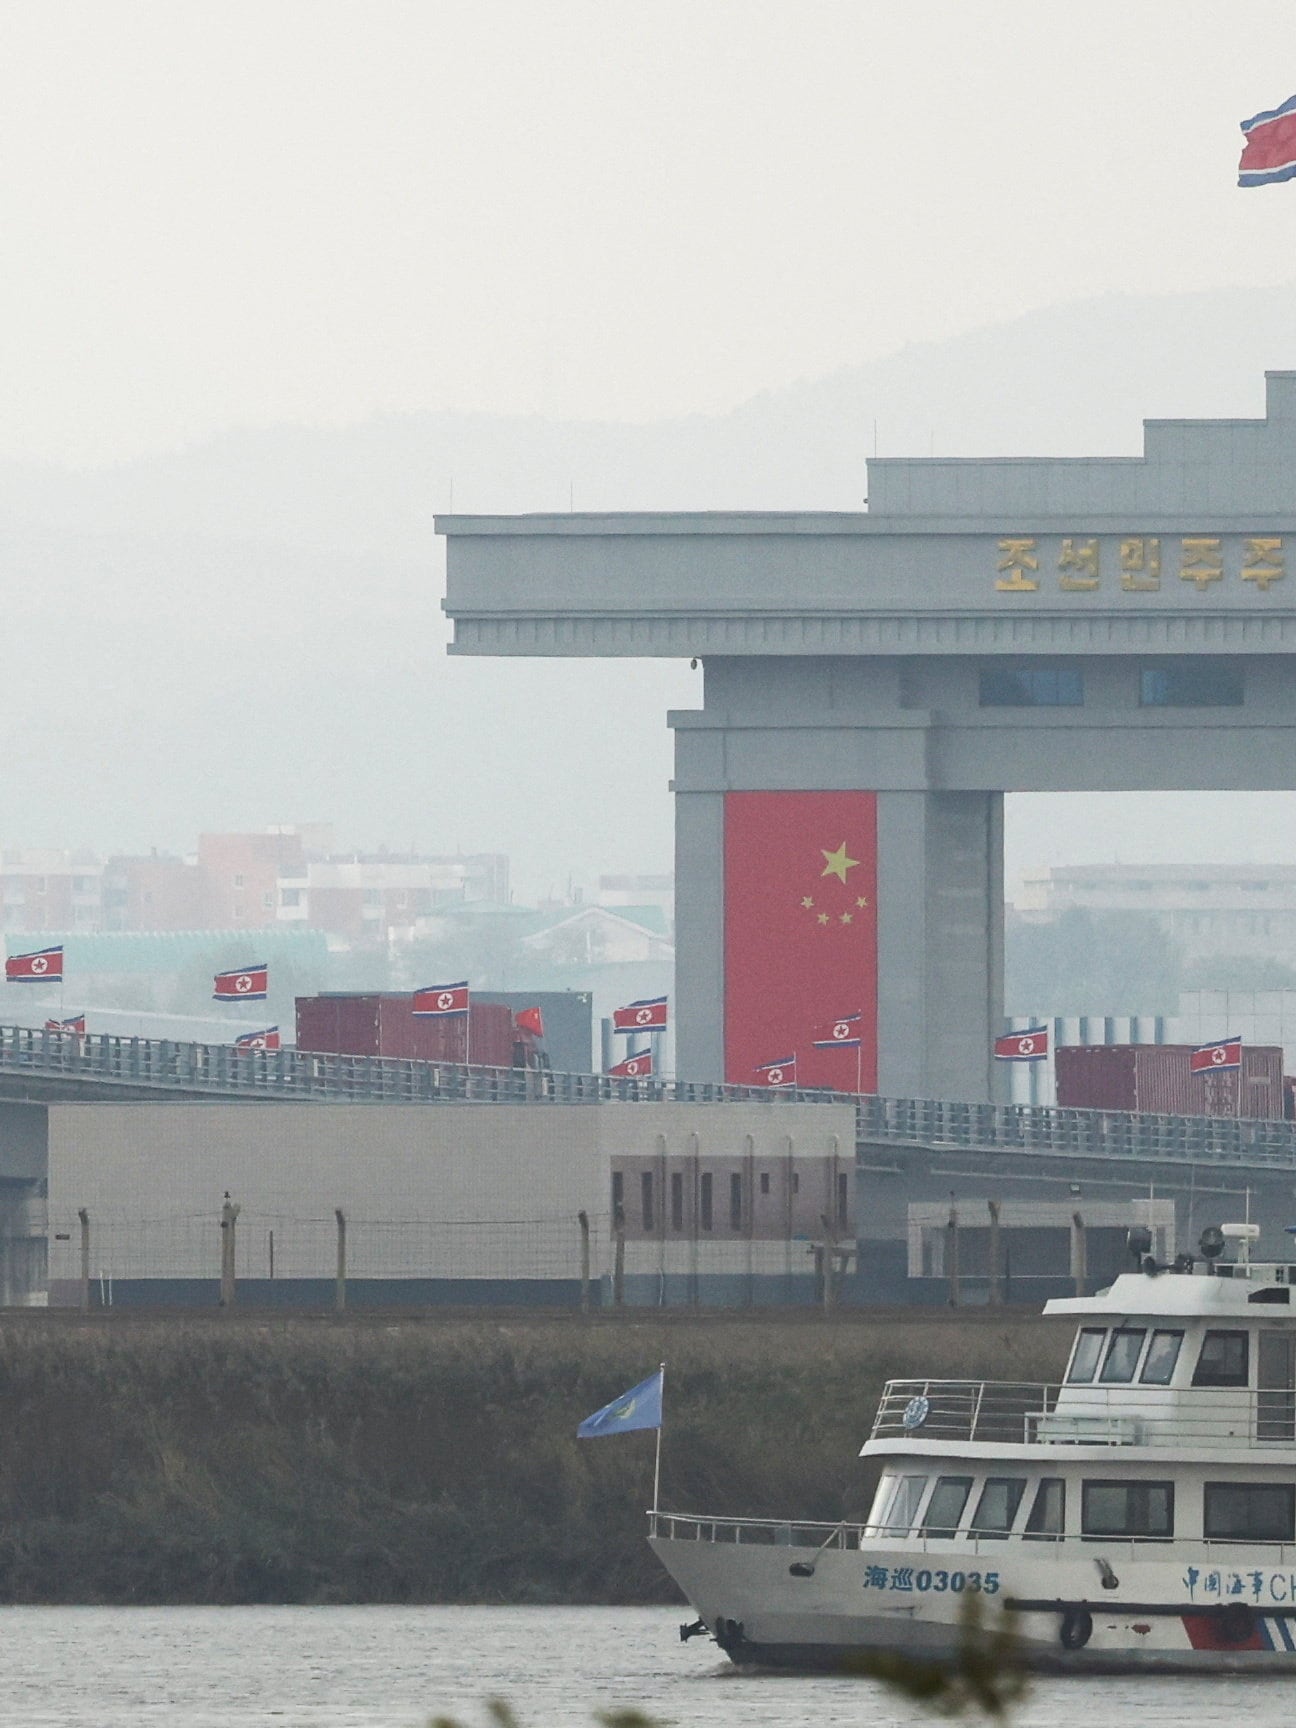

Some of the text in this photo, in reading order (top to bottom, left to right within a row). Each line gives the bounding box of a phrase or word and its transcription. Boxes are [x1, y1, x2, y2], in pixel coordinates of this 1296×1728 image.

[863, 1565, 1000, 1594] 海巡03035
[1182, 1566, 1264, 1603] 中国海事
